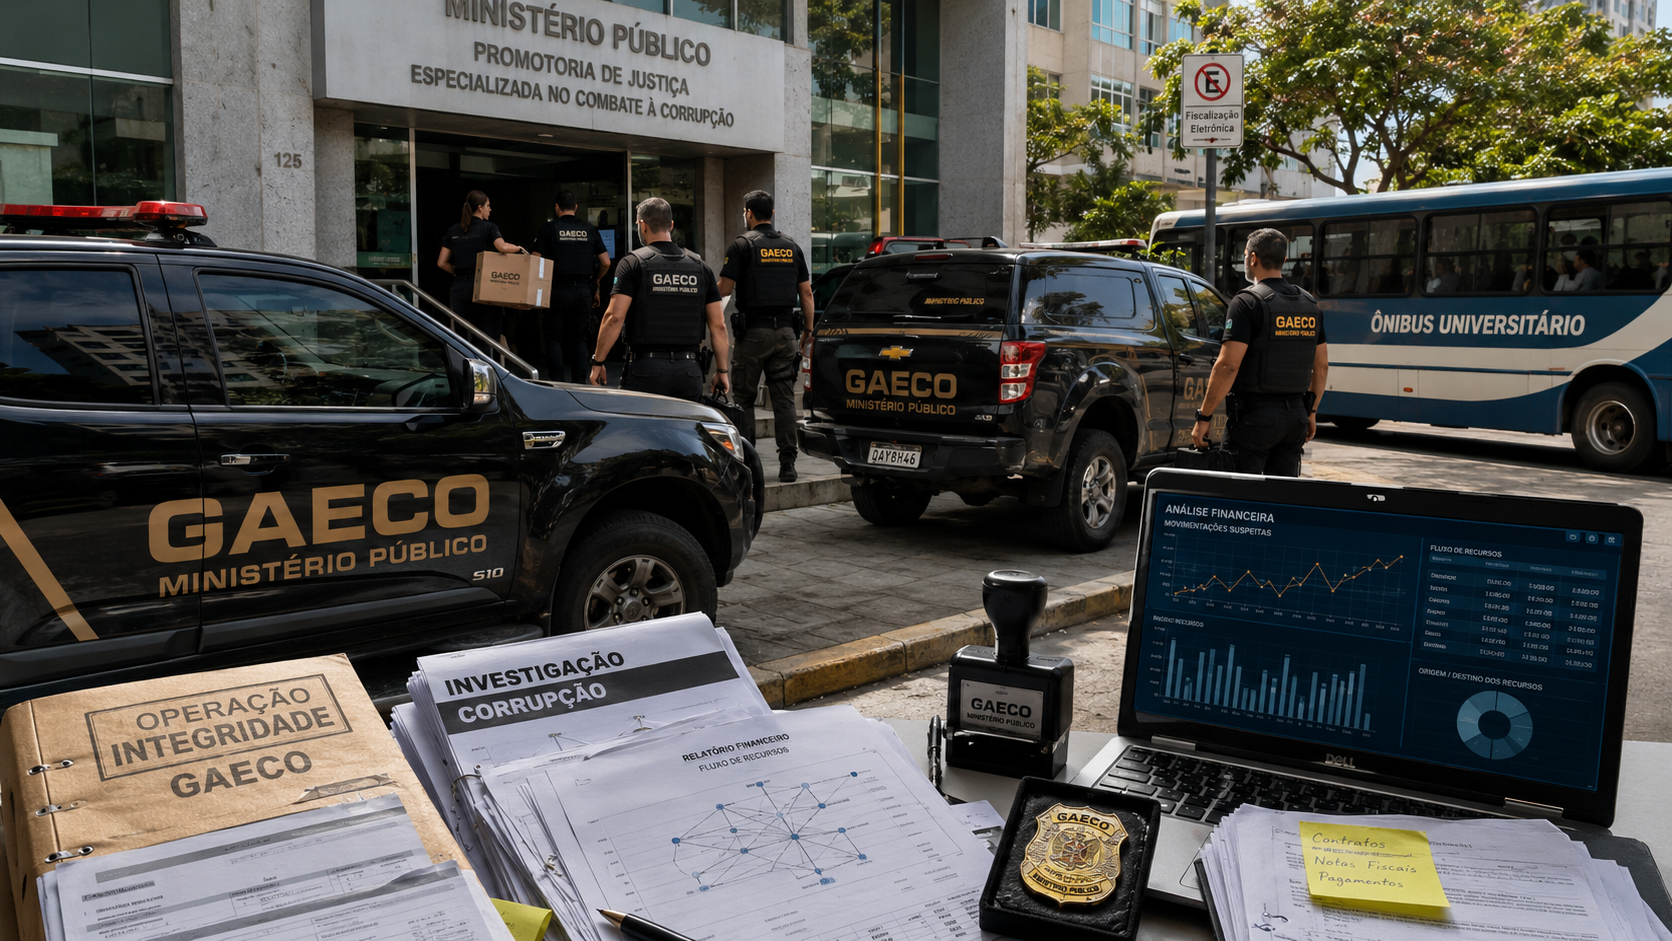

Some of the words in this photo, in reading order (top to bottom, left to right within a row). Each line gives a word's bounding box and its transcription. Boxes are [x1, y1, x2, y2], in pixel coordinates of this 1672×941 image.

[446, 0, 605, 46] MINISTÉRIO
[613, 21, 711, 67] PÚBLICO
[474, 41, 597, 81] PROMOTORIA
[601, 64, 623, 85] DE
[628, 69, 690, 98] JUSTIÇA
[411, 64, 543, 101] ESPECIALIZADA
[548, 85, 571, 105] NO
[575, 89, 643, 115] COMBATE
[647, 97, 657, 117] À
[660, 102, 734, 129] CORRUPÇÃO
[1185, 109, 1239, 121] Fiscalização
[273, 152, 302, 169] 125
[559, 230, 588, 238] GAECO
[760, 248, 793, 258] GAECO
[491, 271, 521, 281] GAECO
[652, 273, 698, 286] GAECO
[1275, 315, 1316, 328] GAECO
[1371, 309, 1434, 334] ÔNIBUS
[1439, 310, 1586, 336] UNIVERSITÁRIO
[845, 369, 957, 399] GAECO
[846, 398, 905, 412] MINISTÉRIO
[908, 400, 956, 415] PÚBLICO
[148, 473, 490, 563] GAECO
[1165, 503, 1209, 517] ANÁLISE
[1211, 508, 1275, 523] FINANCEIRA
[1164, 519, 1228, 533] MOVIMENTAÇÕES
[1229, 525, 1272, 537] SUSPEITAS
[158, 550, 357, 598] MINISTÉRIO
[369, 534, 487, 568] PÚBLICO
[472, 567, 504, 581] S10
[445, 651, 625, 696] INVESTIGAÇÃO
[1418, 667, 1447, 678] ORIGEM
[1452, 672, 1484, 683] DESTINO
[1484, 677, 1501, 686] DOS
[1502, 679, 1543, 691] RECURSOS
[136, 686, 311, 731] OPERAÇÃO
[458, 682, 607, 723] CORRUPÇÃO
[971, 698, 1032, 719] GAECO
[111, 706, 335, 767] INTEGRIDADE
[682, 744, 735, 762] RELATÓRIO
[735, 733, 790, 750] FINANCEIRO
[170, 750, 313, 799] GAECO
[1057, 812, 1110, 830] GAECO
[1312, 832, 1386, 849] Contratos
[1315, 856, 1356, 869] Notas
[1368, 861, 1417, 873] Fiscais
[1319, 871, 1404, 887] Pagamentos
